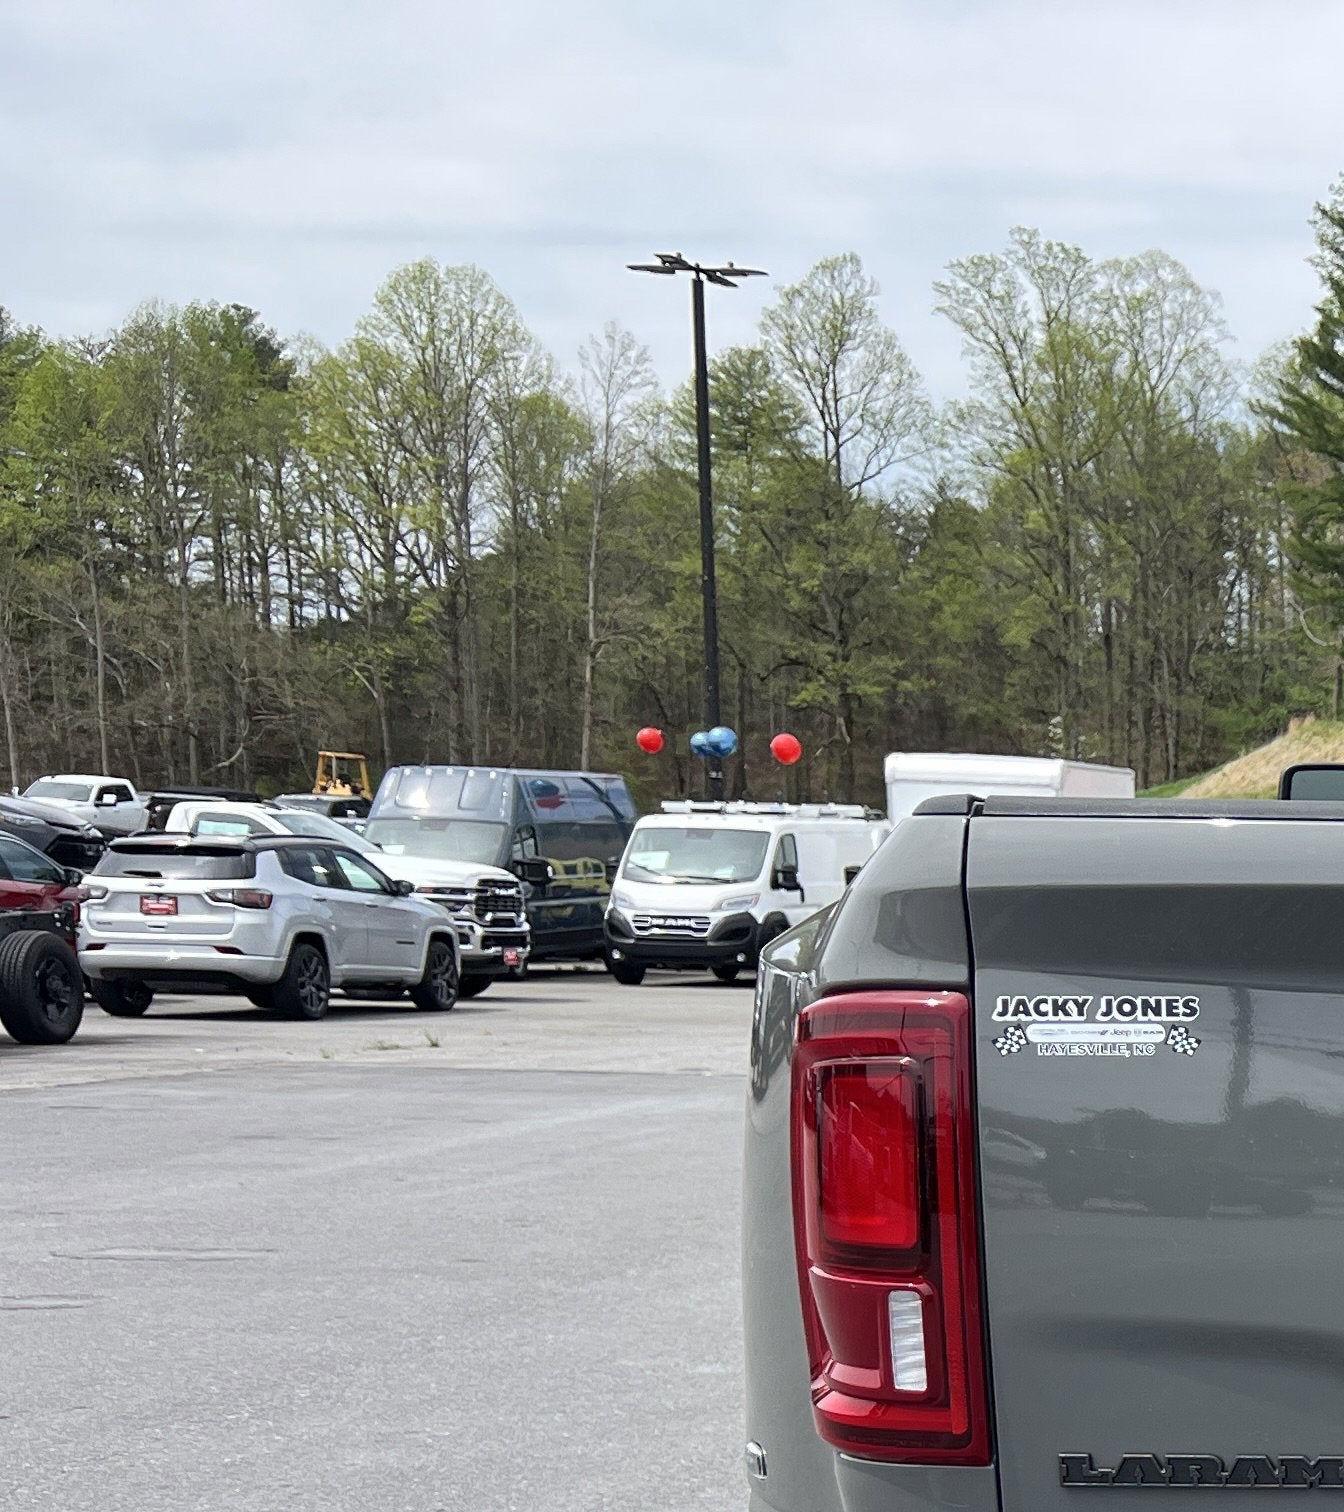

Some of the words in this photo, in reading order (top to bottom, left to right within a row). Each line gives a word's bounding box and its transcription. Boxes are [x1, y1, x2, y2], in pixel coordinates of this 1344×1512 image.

[992, 995, 1093, 1021] JACKY
[1095, 995, 1200, 1021] JONES
[1037, 1043, 1132, 1058] HAYESVILLE,
[1133, 1043, 1156, 1056] NC
